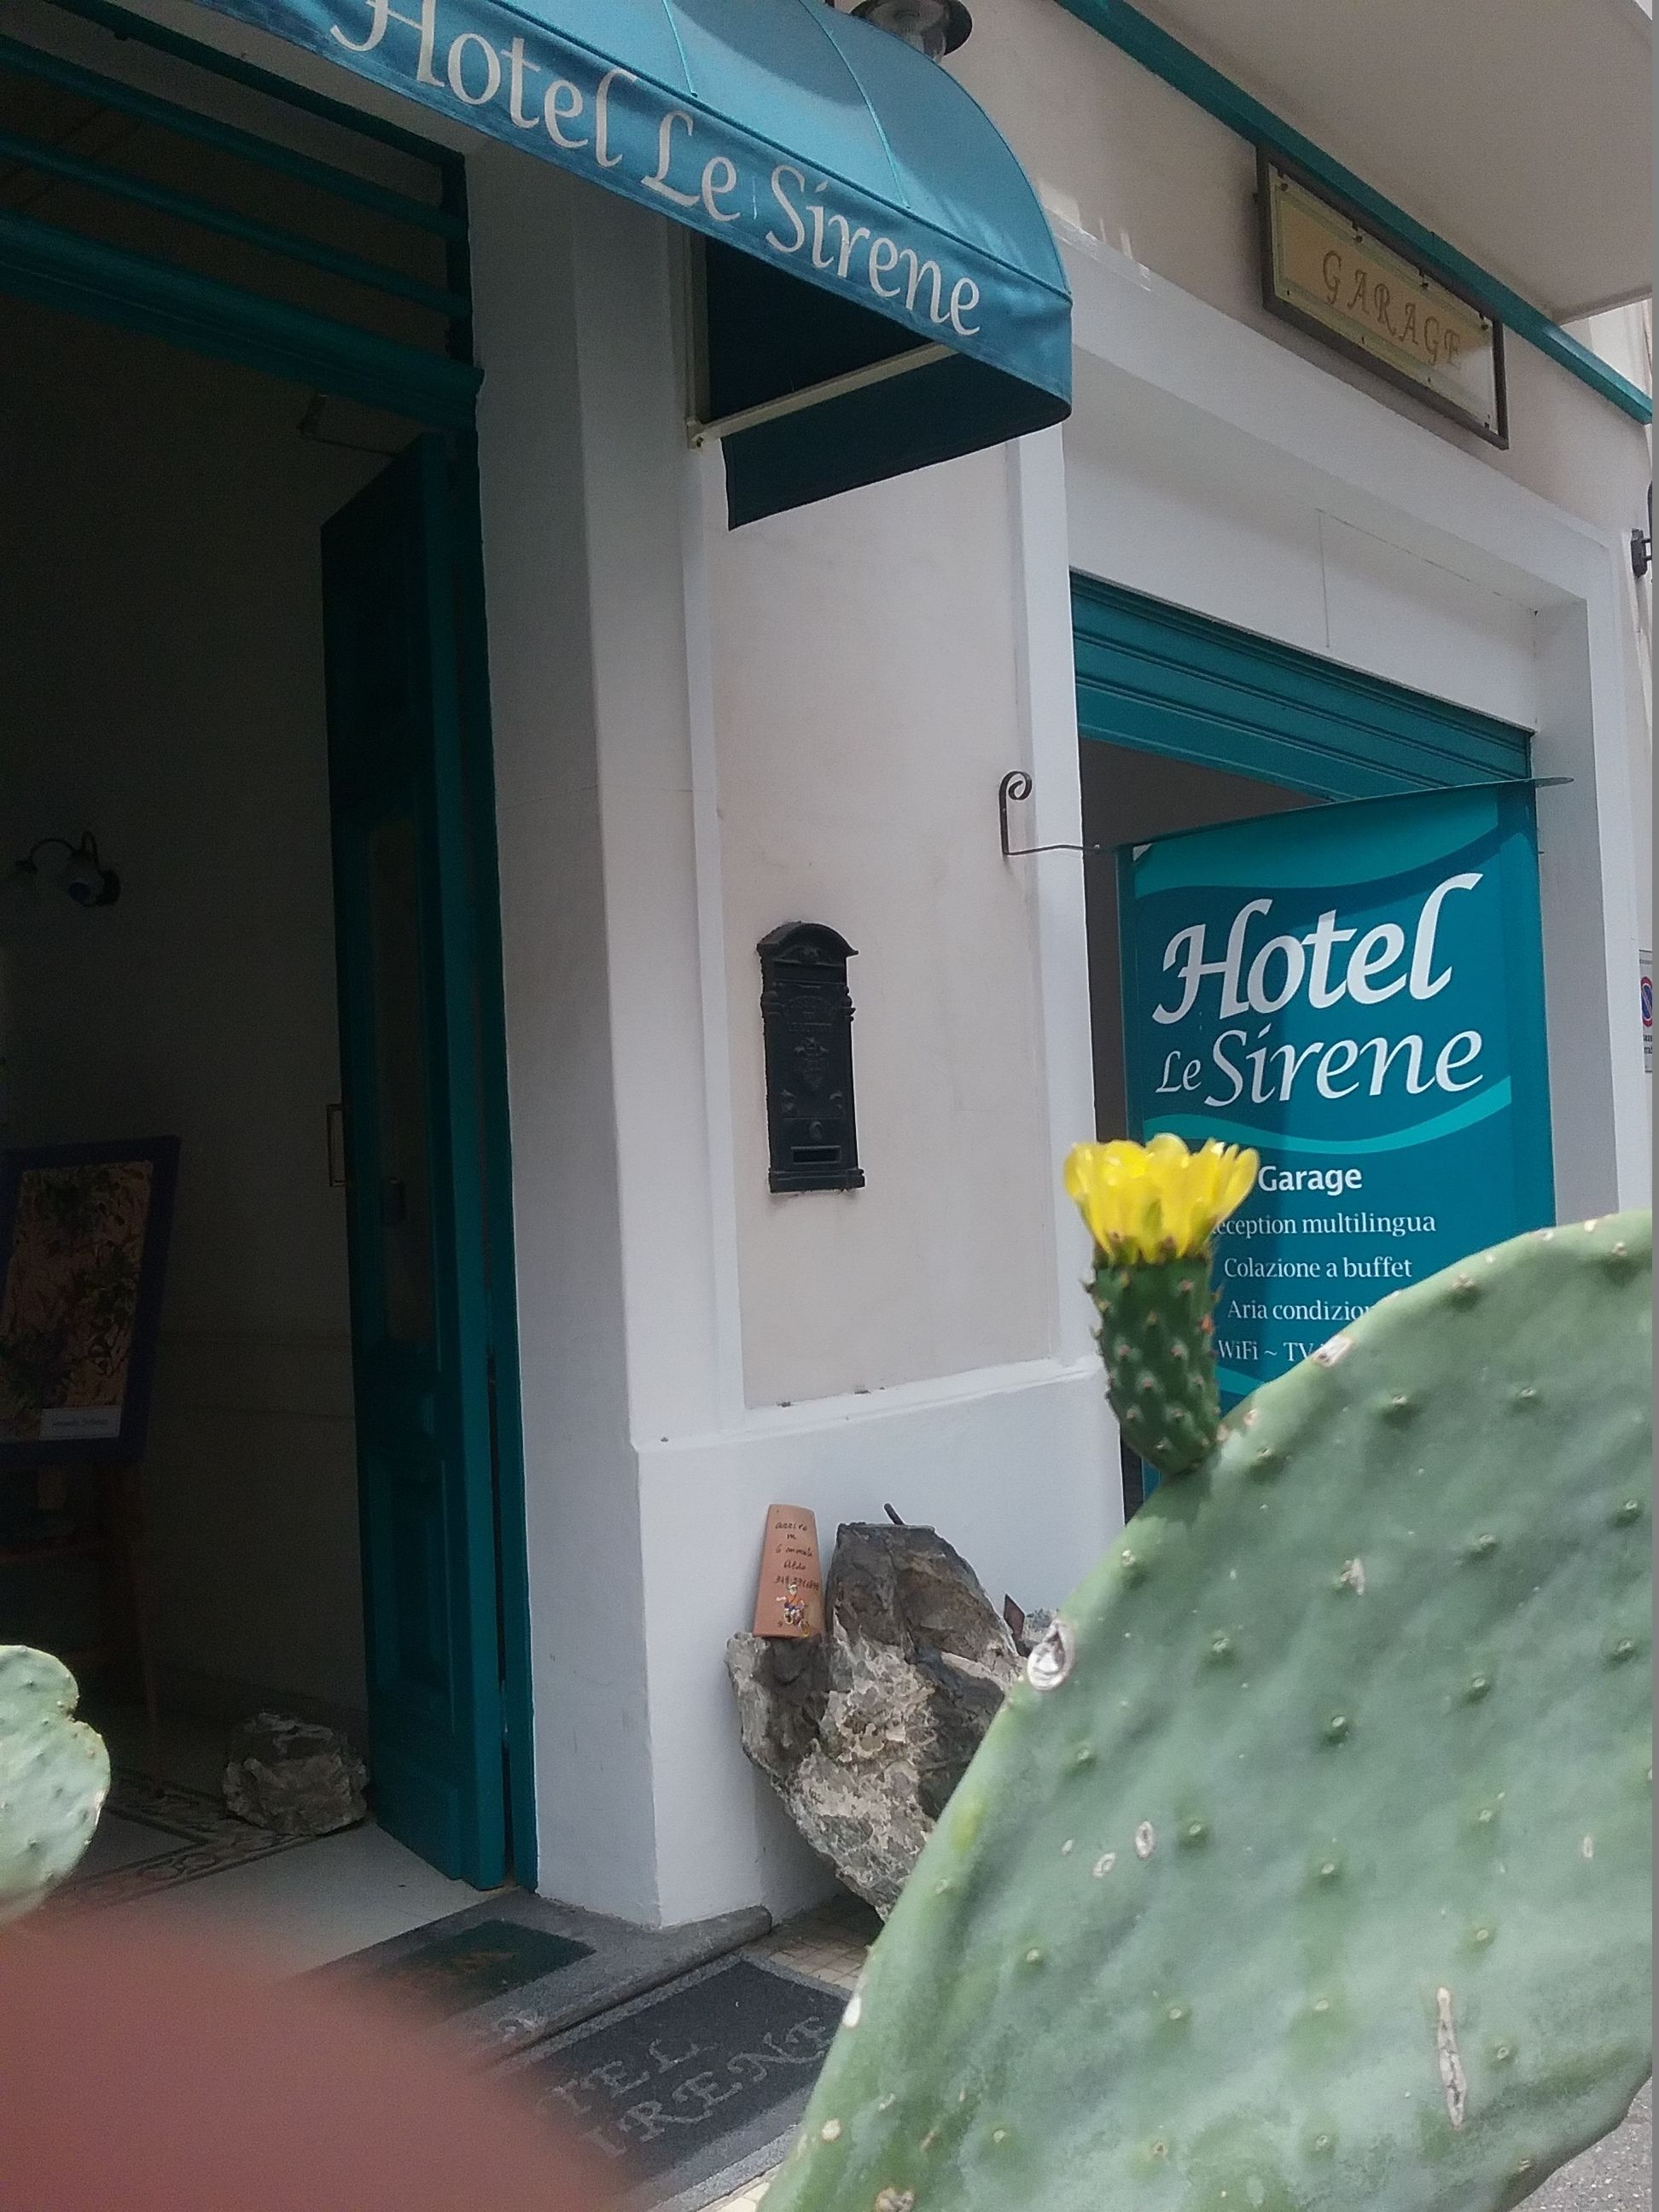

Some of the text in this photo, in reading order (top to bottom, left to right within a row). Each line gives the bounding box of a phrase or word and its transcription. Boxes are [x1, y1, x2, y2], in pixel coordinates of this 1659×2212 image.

[330, 0, 981, 336] Hotel Le Sirene
[1323, 250, 1463, 370] GARAGE
[1151, 872, 1484, 1024] Hotel
[1155, 1023, 1484, 1107] Le Sirene
[1257, 1165, 1363, 1196] Garage
[1213, 1212, 1437, 1239] eception multilingua
[1224, 1256, 1413, 1278] Colazione a buffet
[1227, 1299, 1267, 1320] Aria
[1218, 1339, 1259, 1360] WiFi
[1284, 1342, 1314, 1362] TV
[536, 2038, 722, 2115] TEL
[579, 2016, 834, 2158] IRENE
